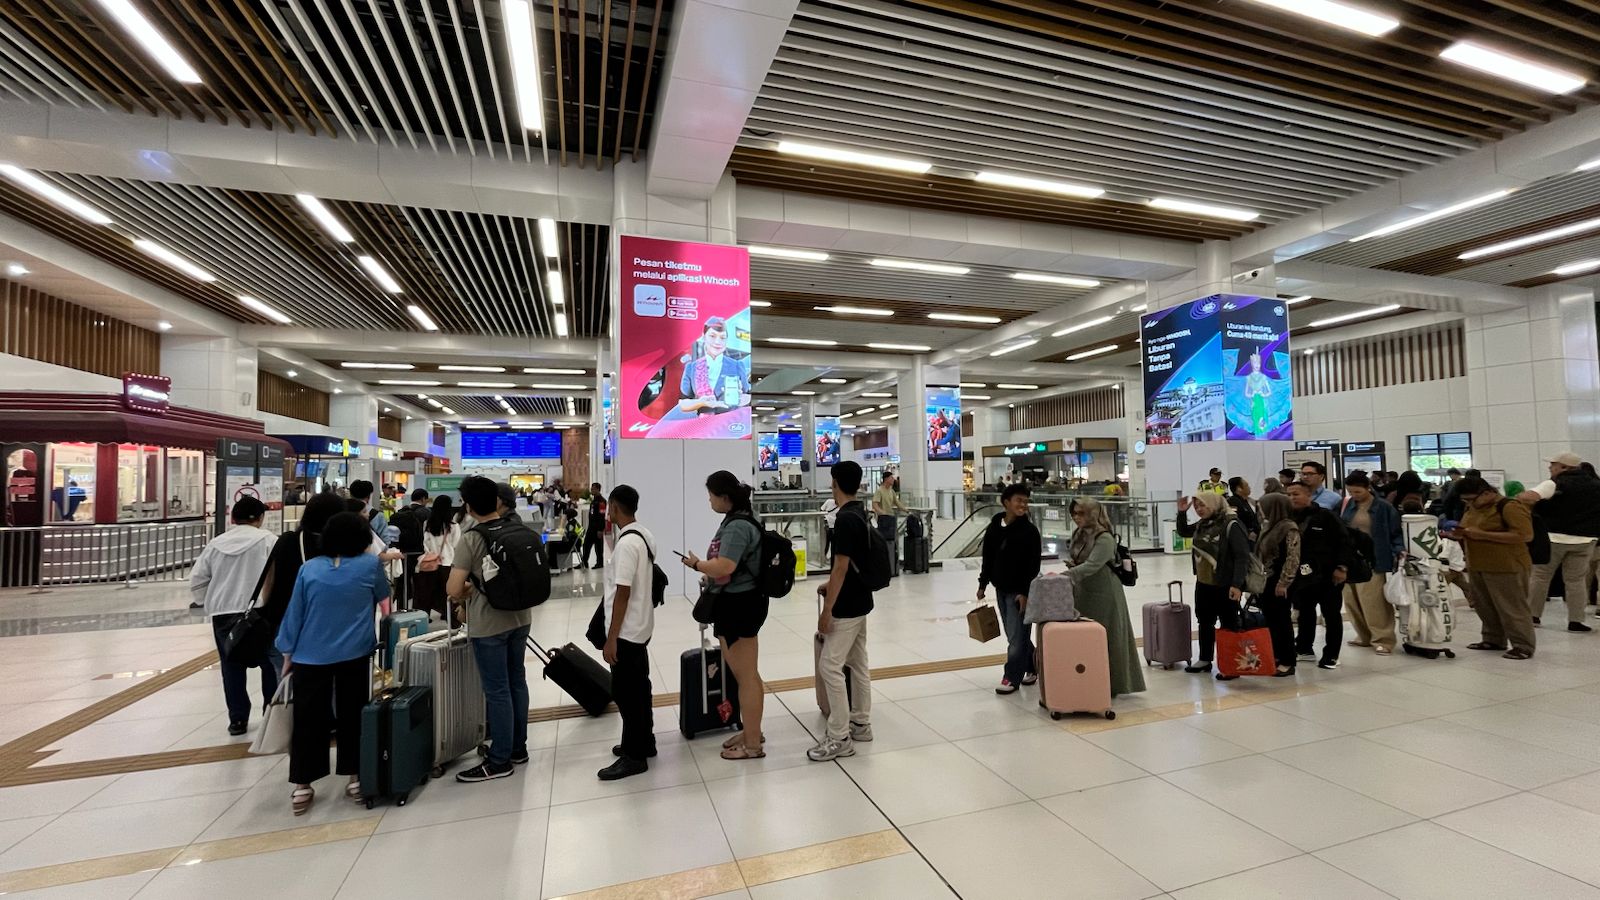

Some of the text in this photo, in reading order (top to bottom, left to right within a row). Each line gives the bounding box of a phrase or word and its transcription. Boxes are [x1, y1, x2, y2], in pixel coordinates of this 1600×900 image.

[633, 257, 702, 272] Pesan tiketmu
[633, 270, 740, 287] melalui aplikasi Whoosh
[1148, 342, 1176, 354] Liburan
[1148, 353, 1171, 363] Tanpa
